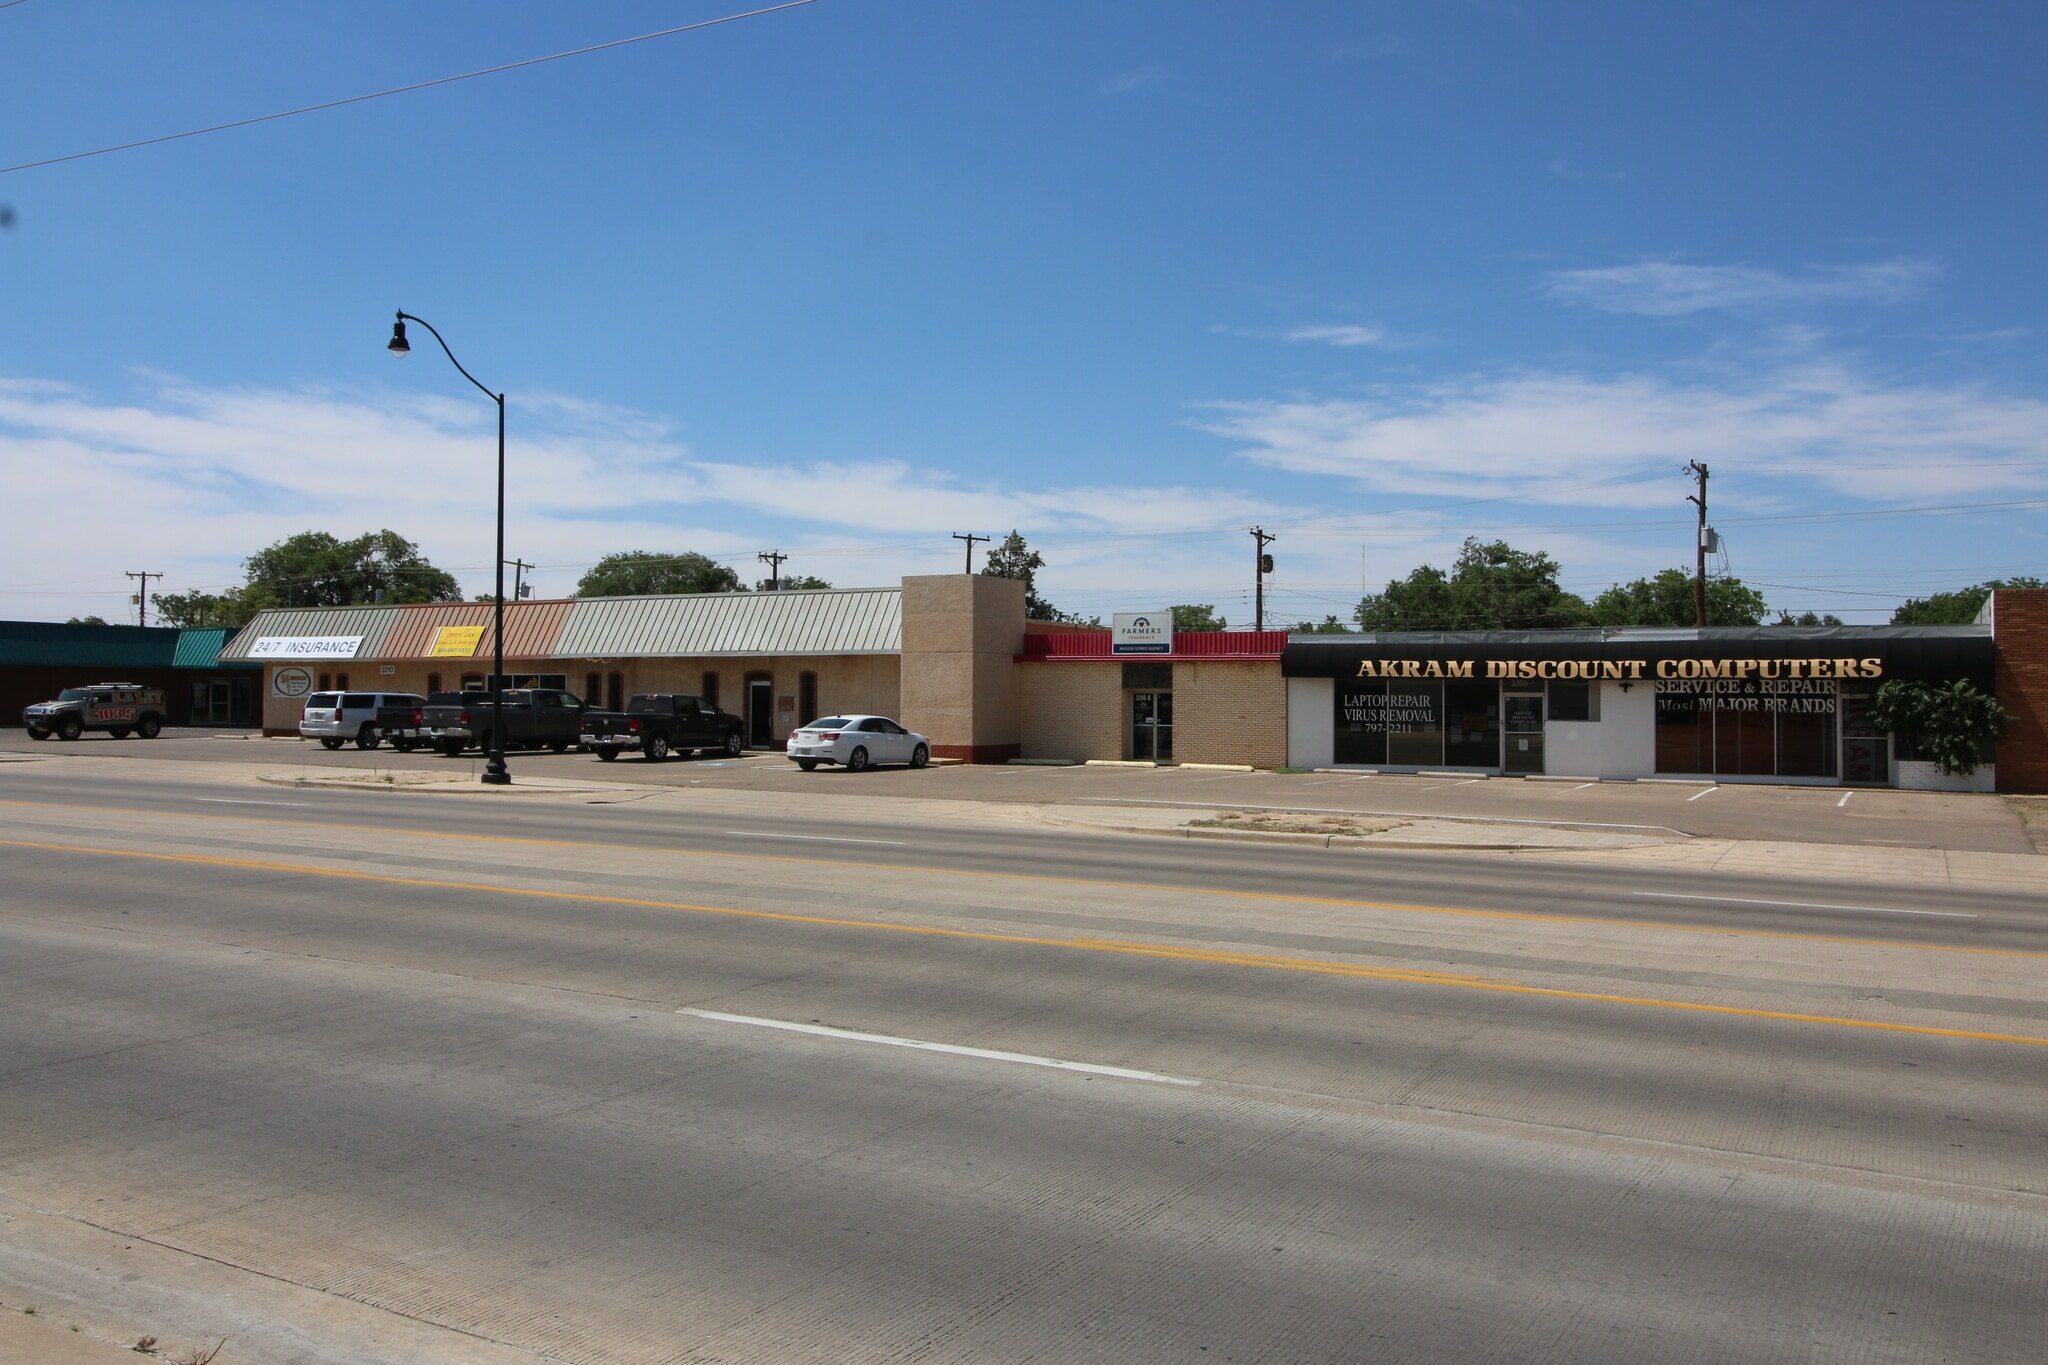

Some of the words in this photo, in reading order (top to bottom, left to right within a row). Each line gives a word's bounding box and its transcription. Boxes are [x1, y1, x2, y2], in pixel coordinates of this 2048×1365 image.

[1122, 627, 1161, 635] FARMERS
[255, 641, 282, 654] 24/7
[286, 641, 357, 654] INSURANCE
[1356, 659, 1475, 678] AKRAM
[1486, 659, 1646, 679] DISCOUNT
[1656, 658, 1883, 679] COMPUTERS
[1655, 679, 1741, 693] SERVICE
[1745, 682, 1756, 693] &
[1759, 679, 1837, 694] REPAIR
[115, 690, 134, 705] LA
[136, 690, 163, 705] LEY
[1344, 694, 1388, 707] LAPTOP
[1390, 694, 1431, 707] REPAIR
[1657, 698, 1694, 711] Most
[1698, 697, 1760, 711] MAJOR
[1763, 697, 1836, 712] BRANDS
[97, 708, 137, 721] 103.5
[1344, 708, 1377, 721] VIRUS
[1379, 709, 1436, 722] REMOVAL
[1365, 723, 1412, 733] 797-2211
